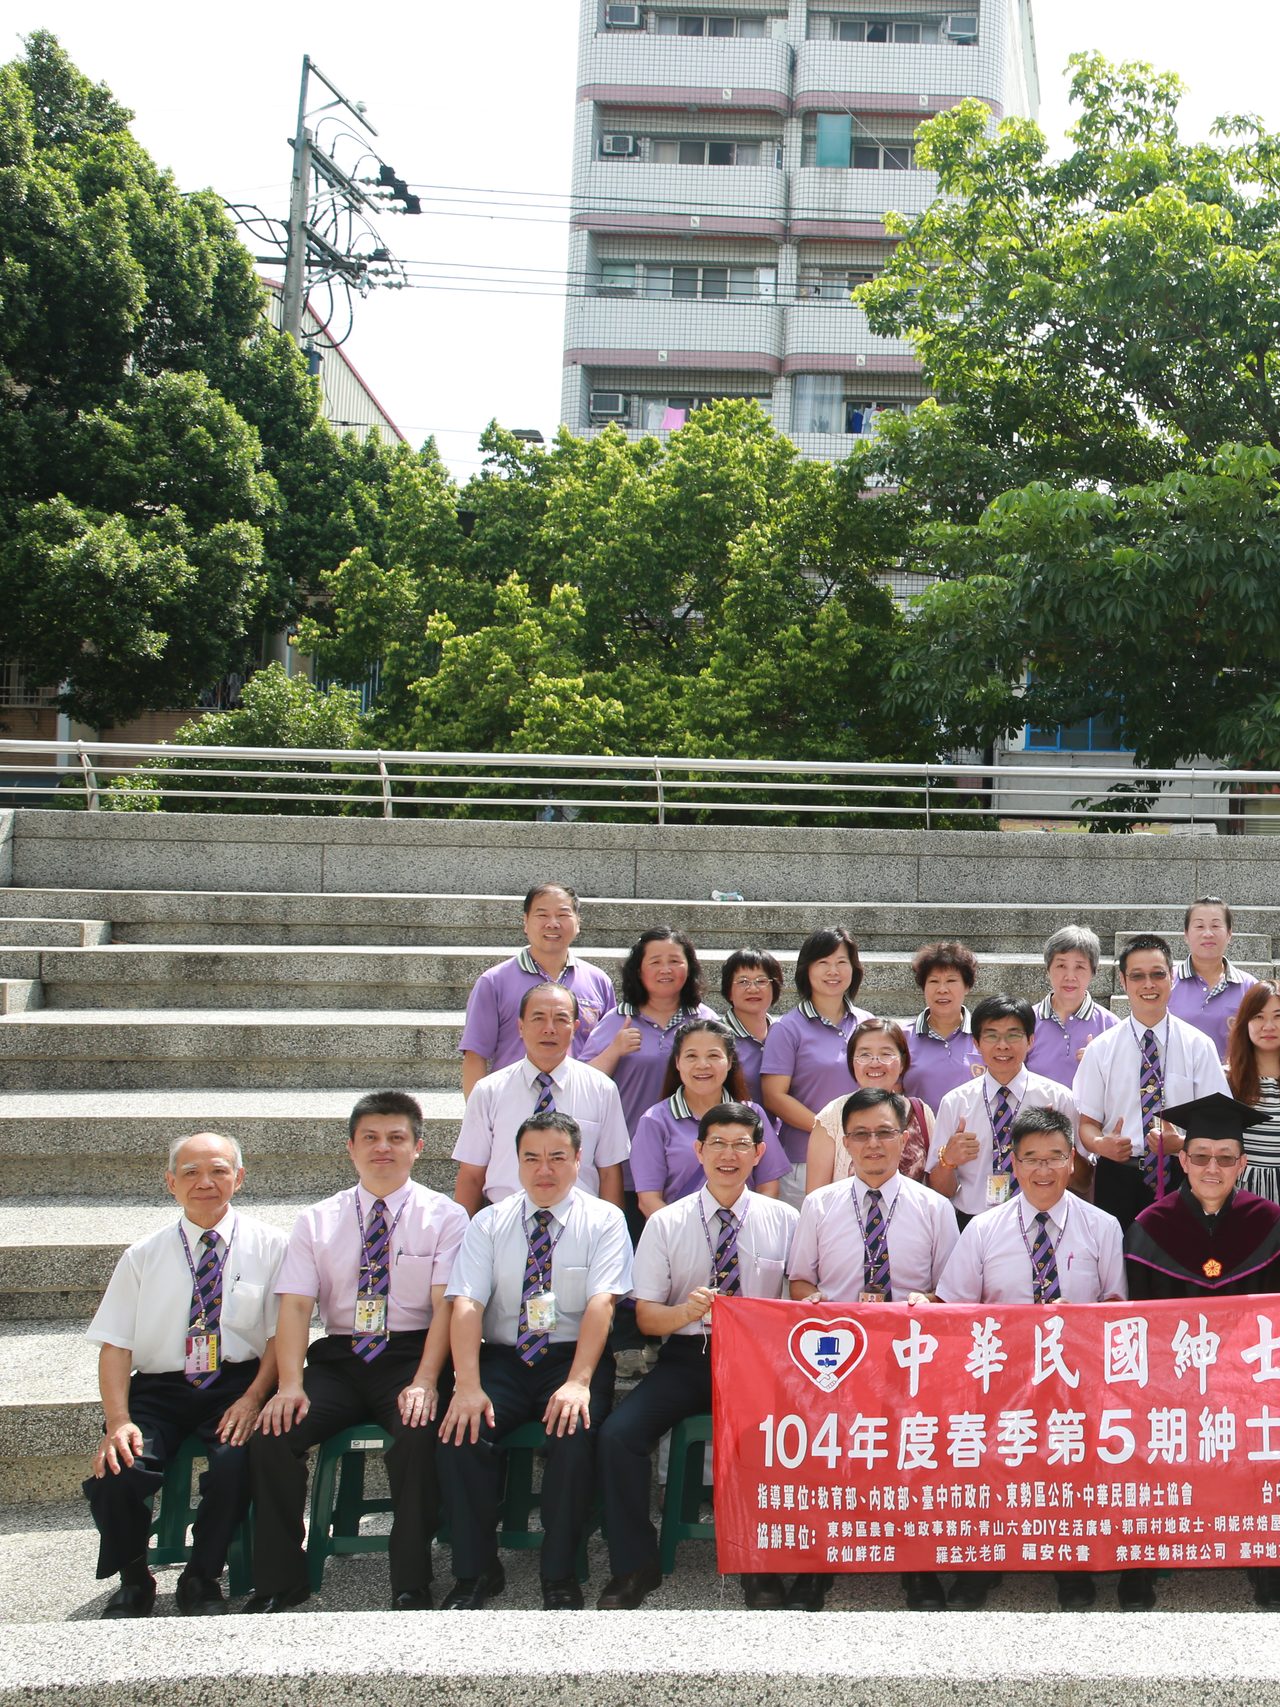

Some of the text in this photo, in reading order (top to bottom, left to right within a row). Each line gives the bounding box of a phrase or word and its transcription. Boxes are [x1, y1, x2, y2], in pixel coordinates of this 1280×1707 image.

[826, 1545, 896, 1563] 欣仙鮮花店
[935, 1543, 1006, 1564] 羅益光老師
[1022, 1543, 1090, 1562] 福安代書
